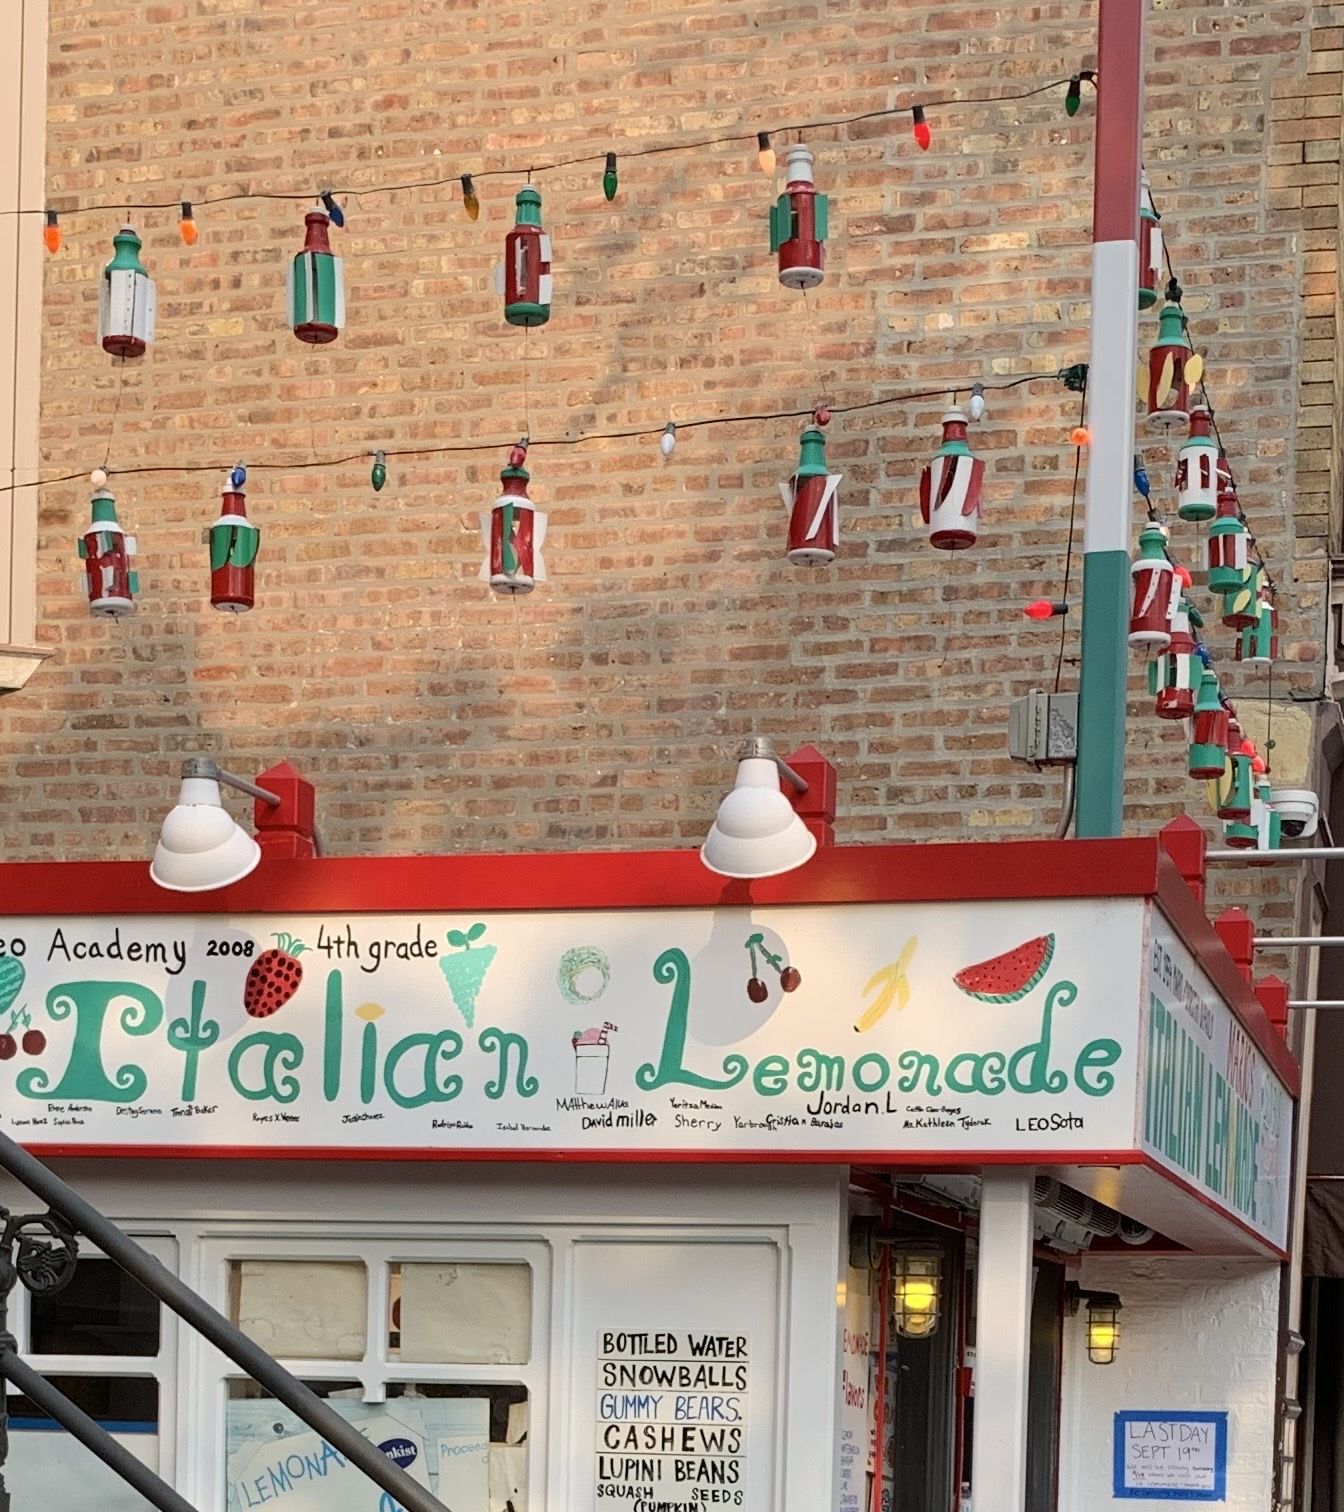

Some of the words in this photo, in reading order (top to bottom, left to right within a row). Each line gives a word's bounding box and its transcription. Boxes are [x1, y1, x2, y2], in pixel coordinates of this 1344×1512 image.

[47, 927, 187, 975] Academy
[207, 940, 255, 958] 2008
[317, 924, 359, 960] 4th
[362, 923, 439, 974] grade
[16, 967, 540, 1109] Italian
[635, 946, 1123, 1097] Lemonade
[674, 1114, 722, 1131] Sherry
[603, 1332, 678, 1354] BOTTLED
[688, 1334, 747, 1358] WATER
[603, 1362, 747, 1391] SNOWBALLS
[600, 1393, 663, 1420] GUMMY
[674, 1396, 743, 1421] BEARS.
[604, 1424, 742, 1454] CASHEWS
[1129, 1422, 1179, 1442] LAST
[1179, 1424, 1209, 1444] DAY
[385, 1444, 416, 1459] nkist
[1132, 1445, 1172, 1460] SEPT
[598, 1455, 662, 1481] LUPINI
[675, 1459, 740, 1484] BEANS
[596, 1484, 654, 1500] SQUASH
[691, 1487, 744, 1506] SEEDS
